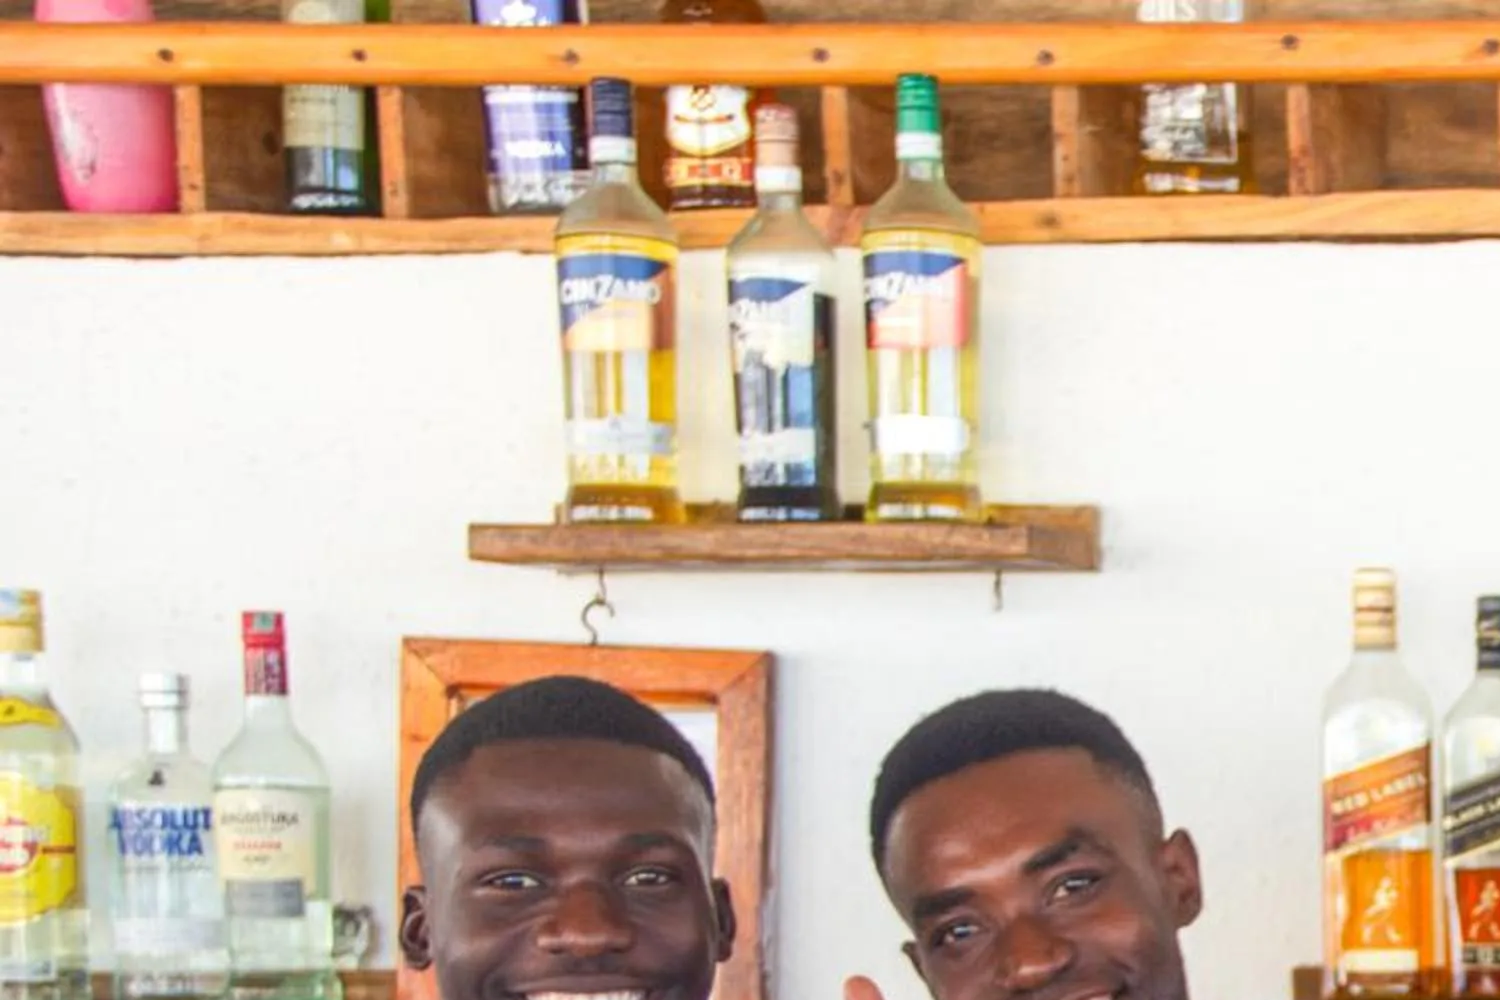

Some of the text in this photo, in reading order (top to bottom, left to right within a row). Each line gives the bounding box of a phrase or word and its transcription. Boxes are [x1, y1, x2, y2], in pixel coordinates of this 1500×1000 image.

[562, 274, 660, 305] CINZANO
[1331, 771, 1427, 815] RED LABEL
[110, 807, 212, 830] ABSOLUT
[118, 832, 203, 856] VODKA
